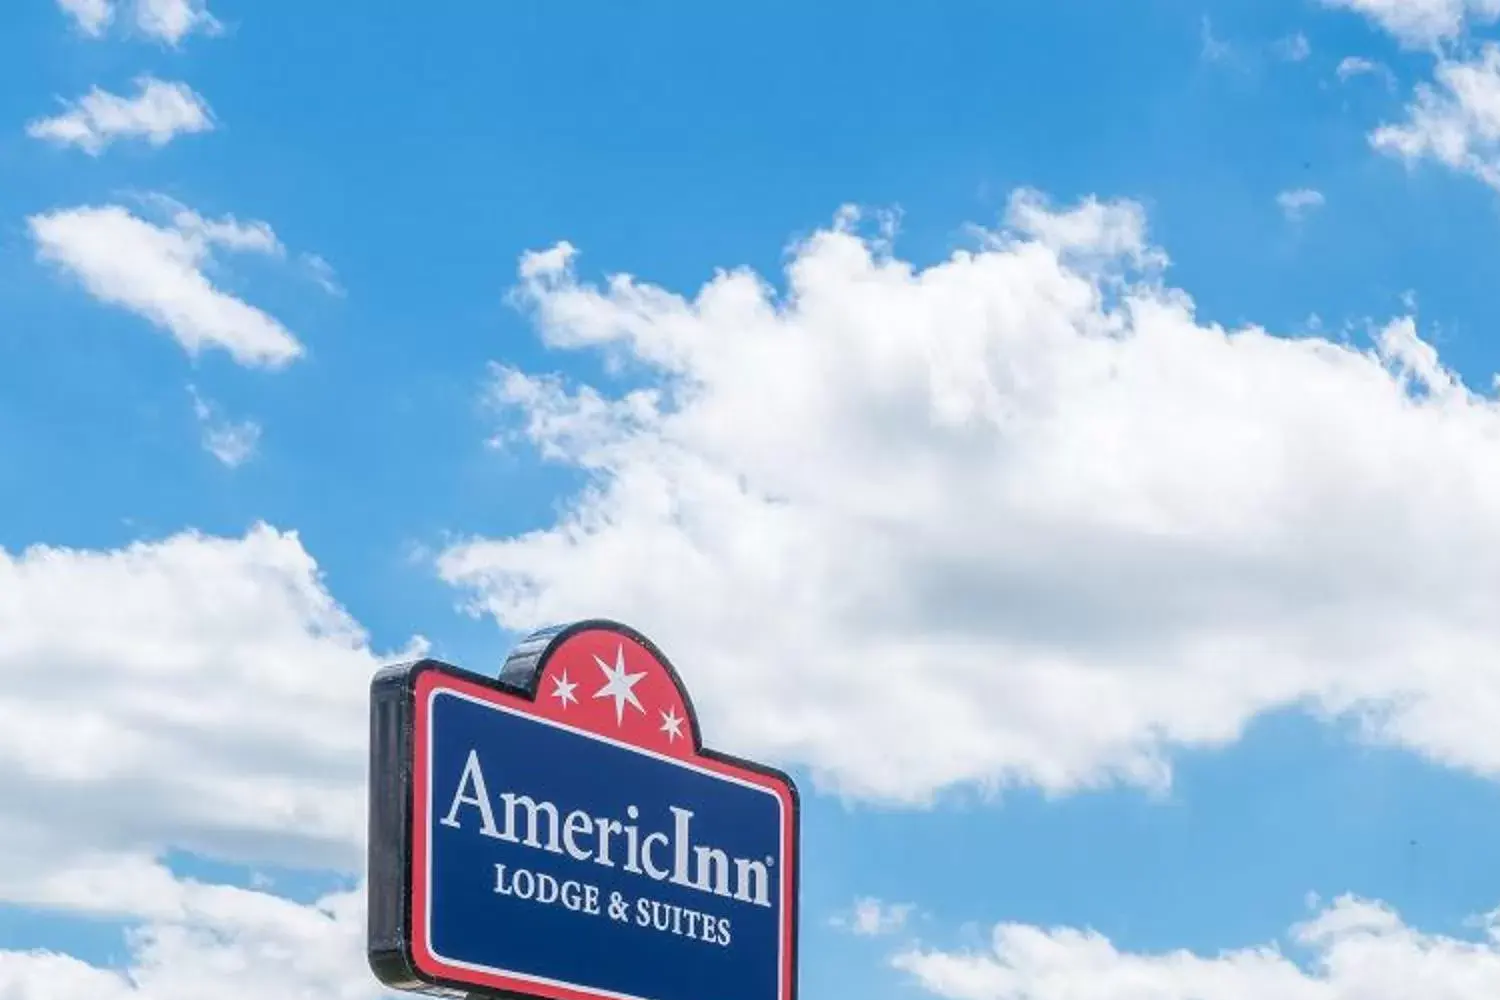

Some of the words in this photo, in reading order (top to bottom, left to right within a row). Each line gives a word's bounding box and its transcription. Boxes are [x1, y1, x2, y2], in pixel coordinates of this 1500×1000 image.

[494, 863, 600, 915] LODGE
[608, 891, 629, 923] &
[636, 899, 732, 946] SUITES
